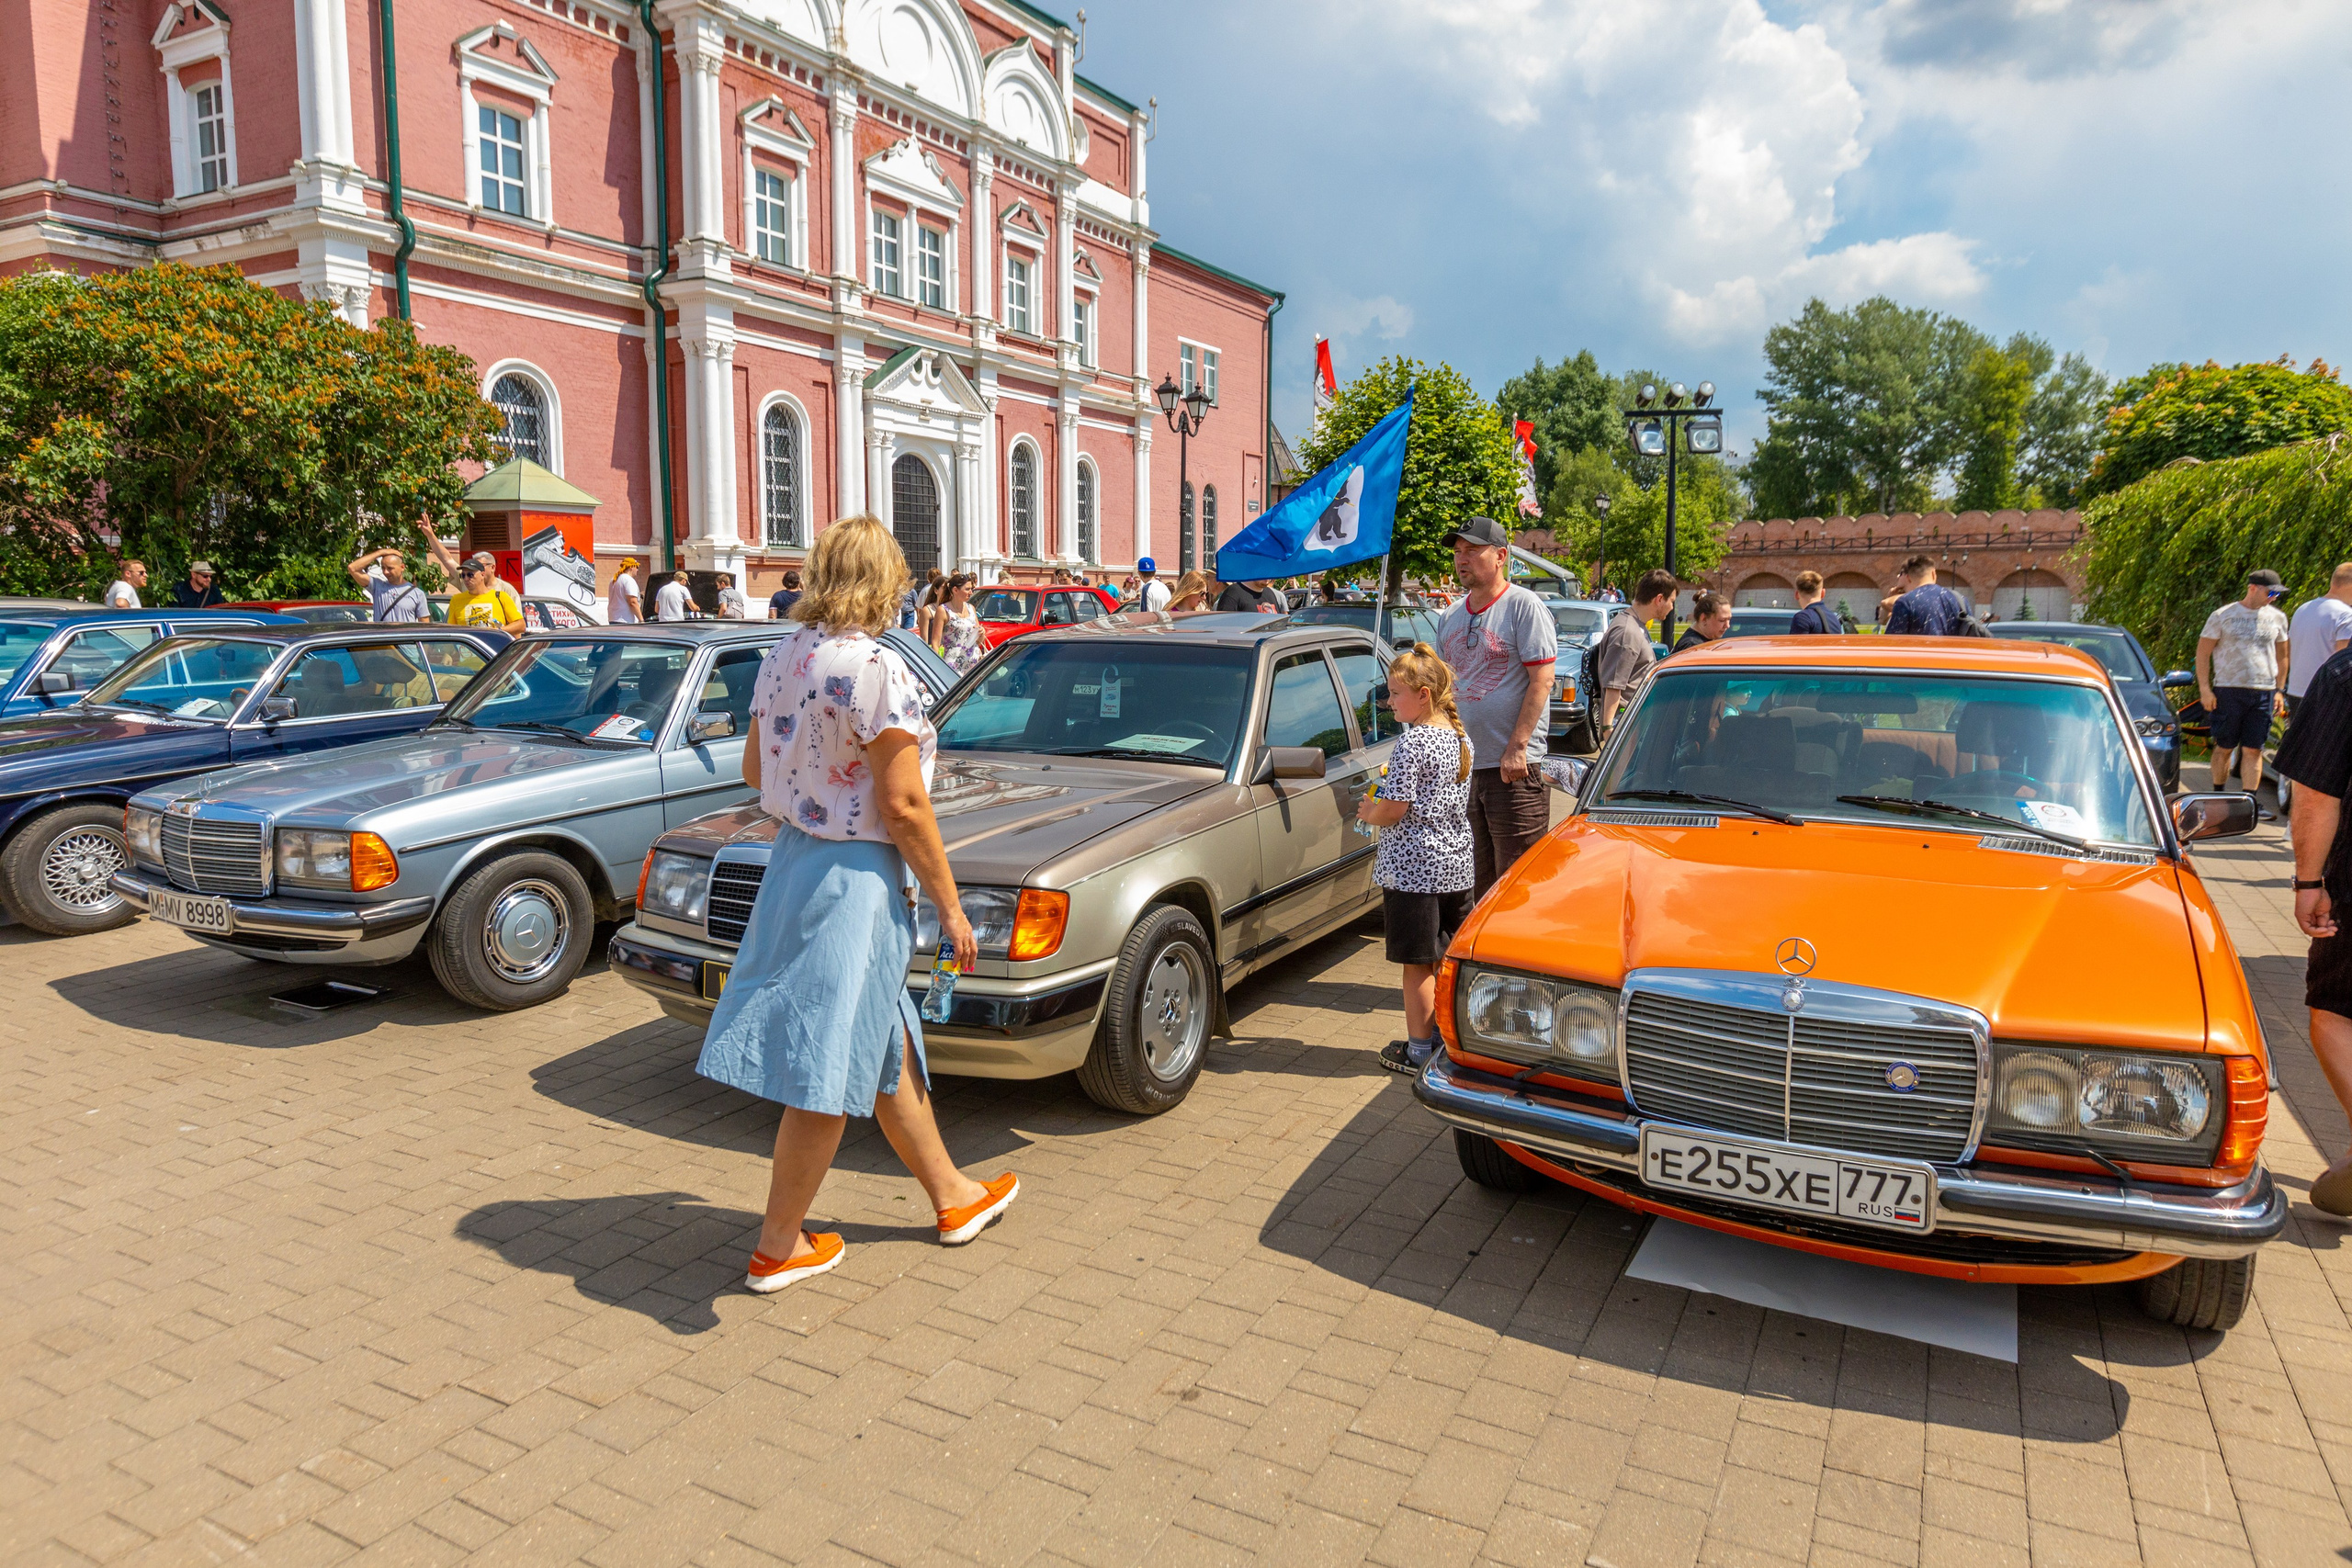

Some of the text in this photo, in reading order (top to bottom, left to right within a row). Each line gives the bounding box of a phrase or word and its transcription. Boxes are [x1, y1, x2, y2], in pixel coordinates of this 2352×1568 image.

[186, 900, 225, 927] 8998
[1170, 921, 1201, 937] GISLAVED
[1380, 1057, 1405, 1072] crocs
[1842, 1166, 1913, 1206] 777
[1859, 1201, 1893, 1218] RUS
